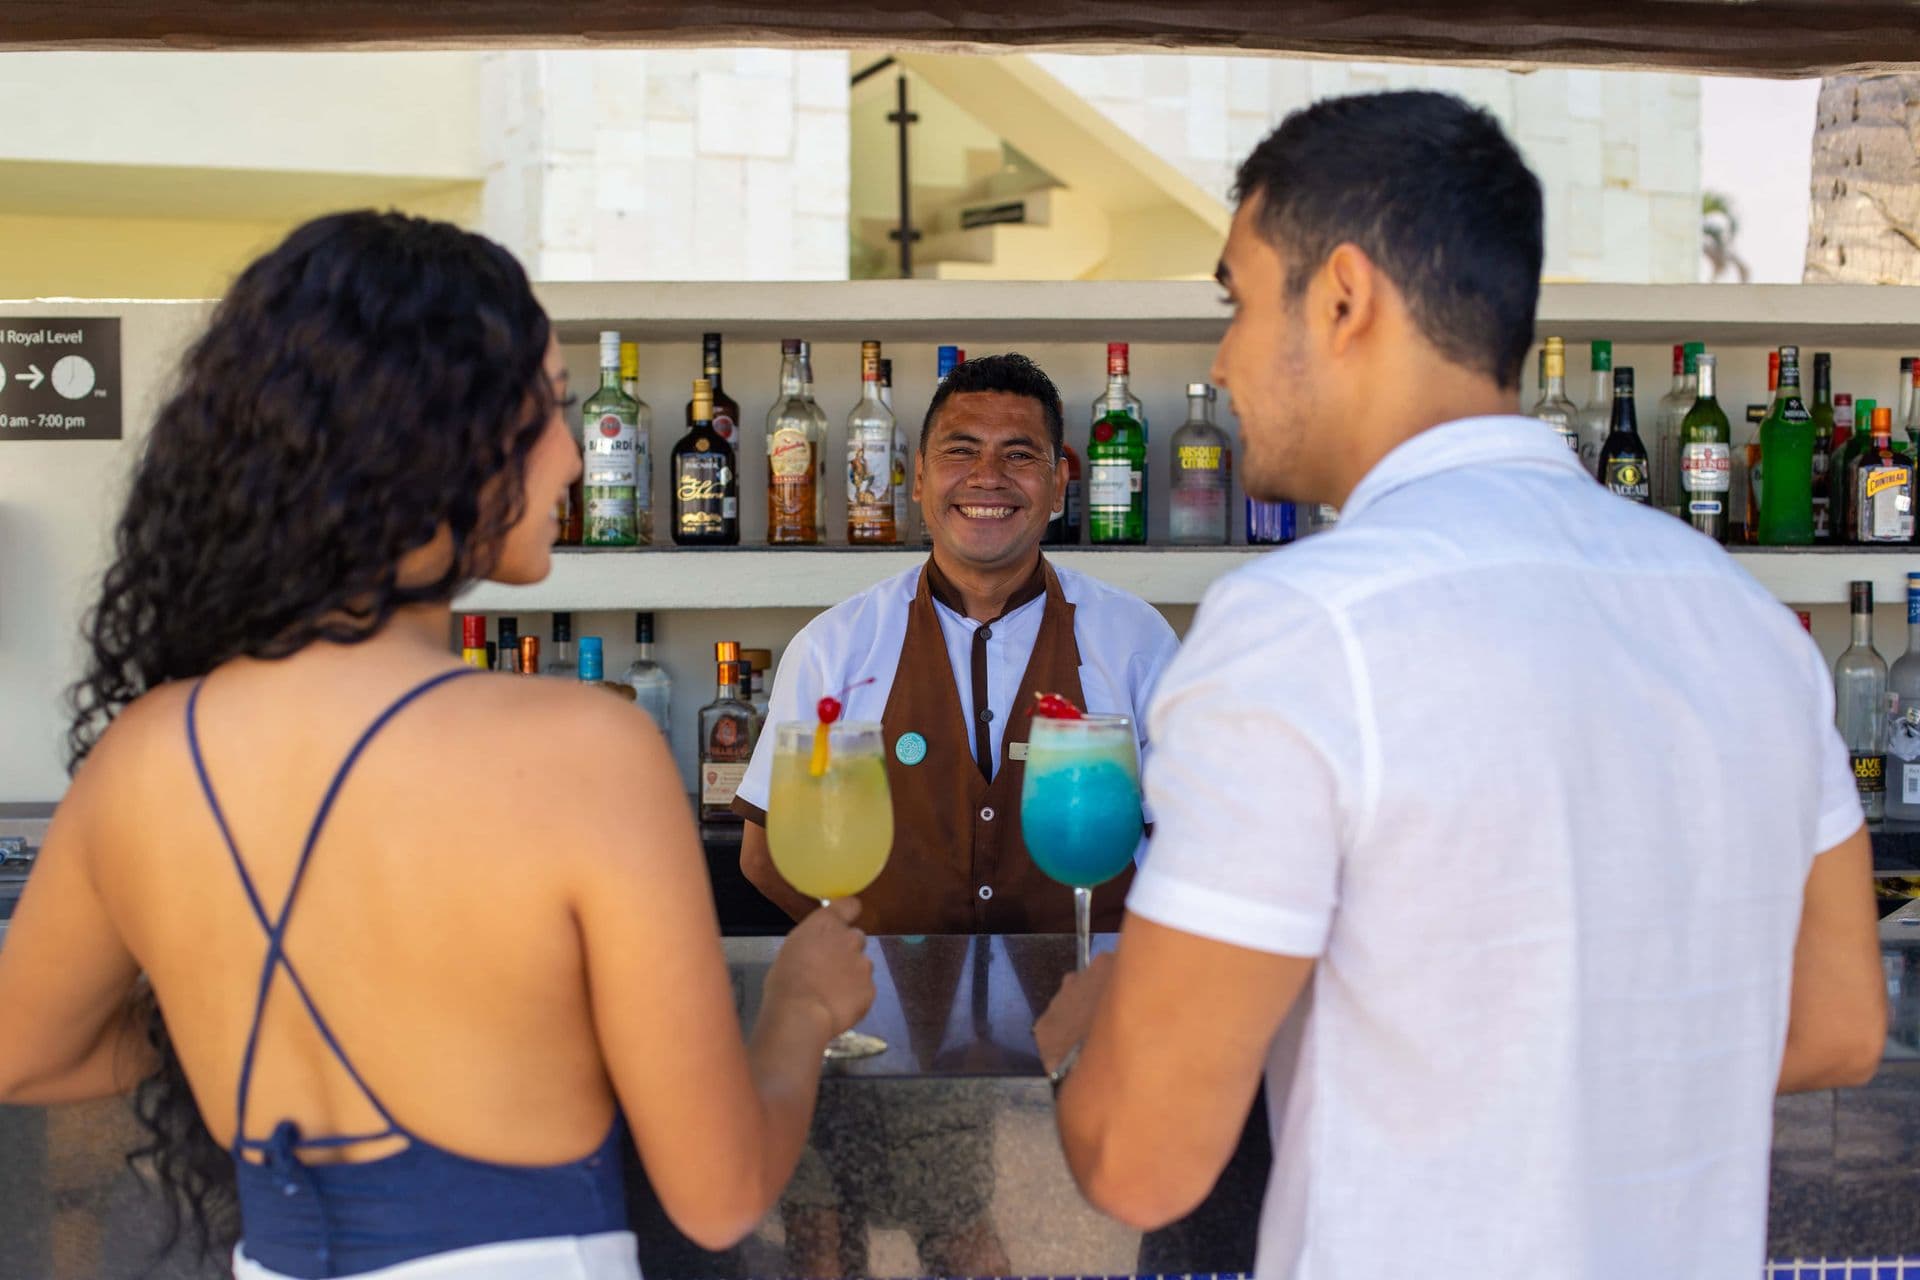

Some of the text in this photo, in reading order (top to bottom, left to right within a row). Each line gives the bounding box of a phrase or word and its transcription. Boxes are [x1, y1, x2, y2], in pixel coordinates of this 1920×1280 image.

[7, 329, 44, 346] Royal
[47, 329, 83, 344] Level
[9, 416, 29, 427] am
[38, 414, 63, 427] 7:00
[65, 416, 85, 430] pm
[589, 438, 633, 450] BAARDÍ
[1178, 446, 1222, 458] ABSOLUT
[1855, 757, 1880, 768] LIVE
[1855, 768, 1881, 778] COCO
